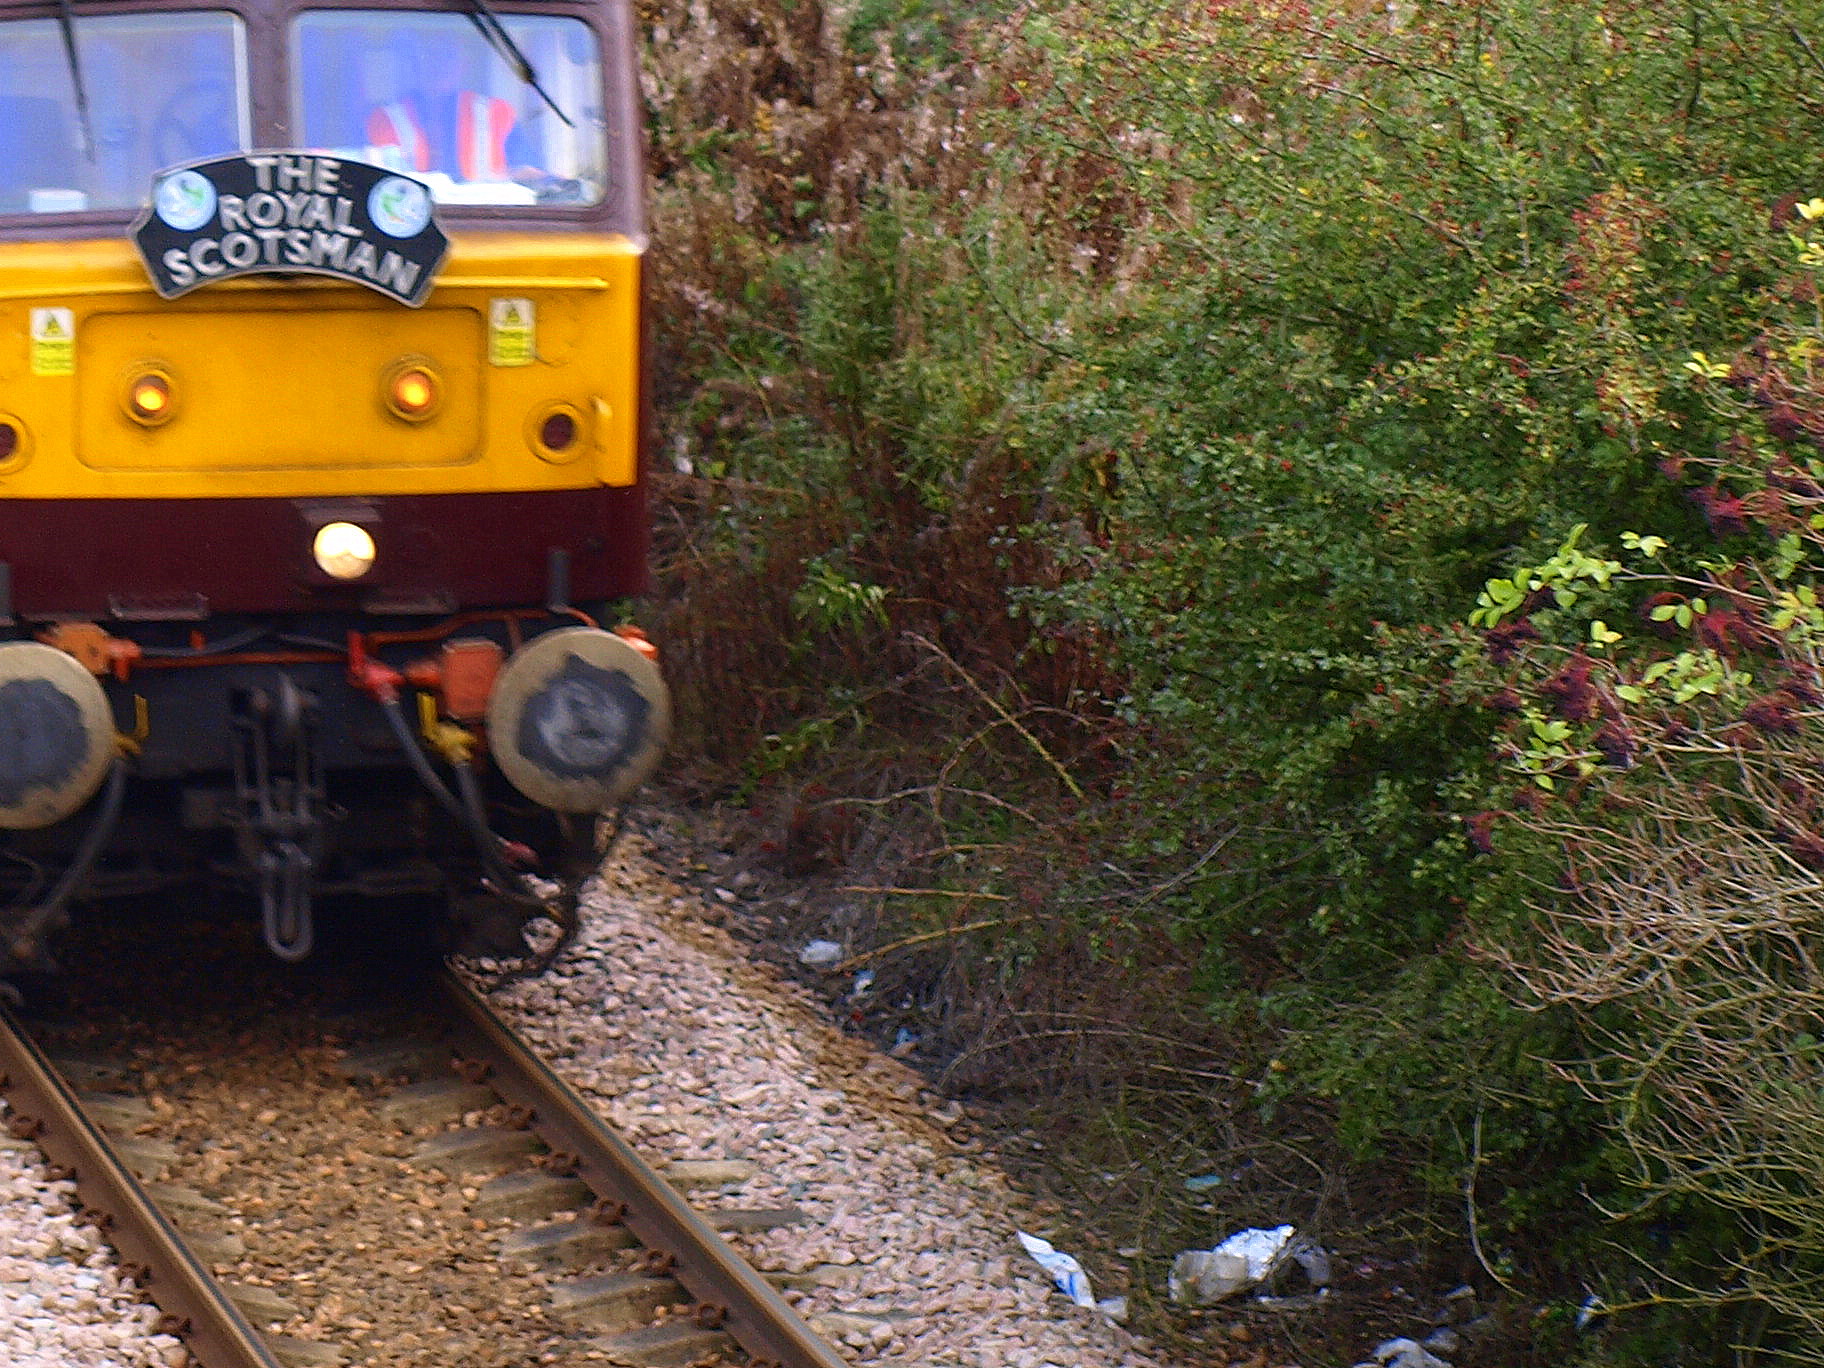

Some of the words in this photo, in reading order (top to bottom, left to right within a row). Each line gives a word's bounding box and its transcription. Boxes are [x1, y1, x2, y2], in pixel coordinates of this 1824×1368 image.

[246, 156, 342, 194] THE
[219, 193, 364, 237] ROYAL
[163, 230, 421, 293] SCOTSMAN
